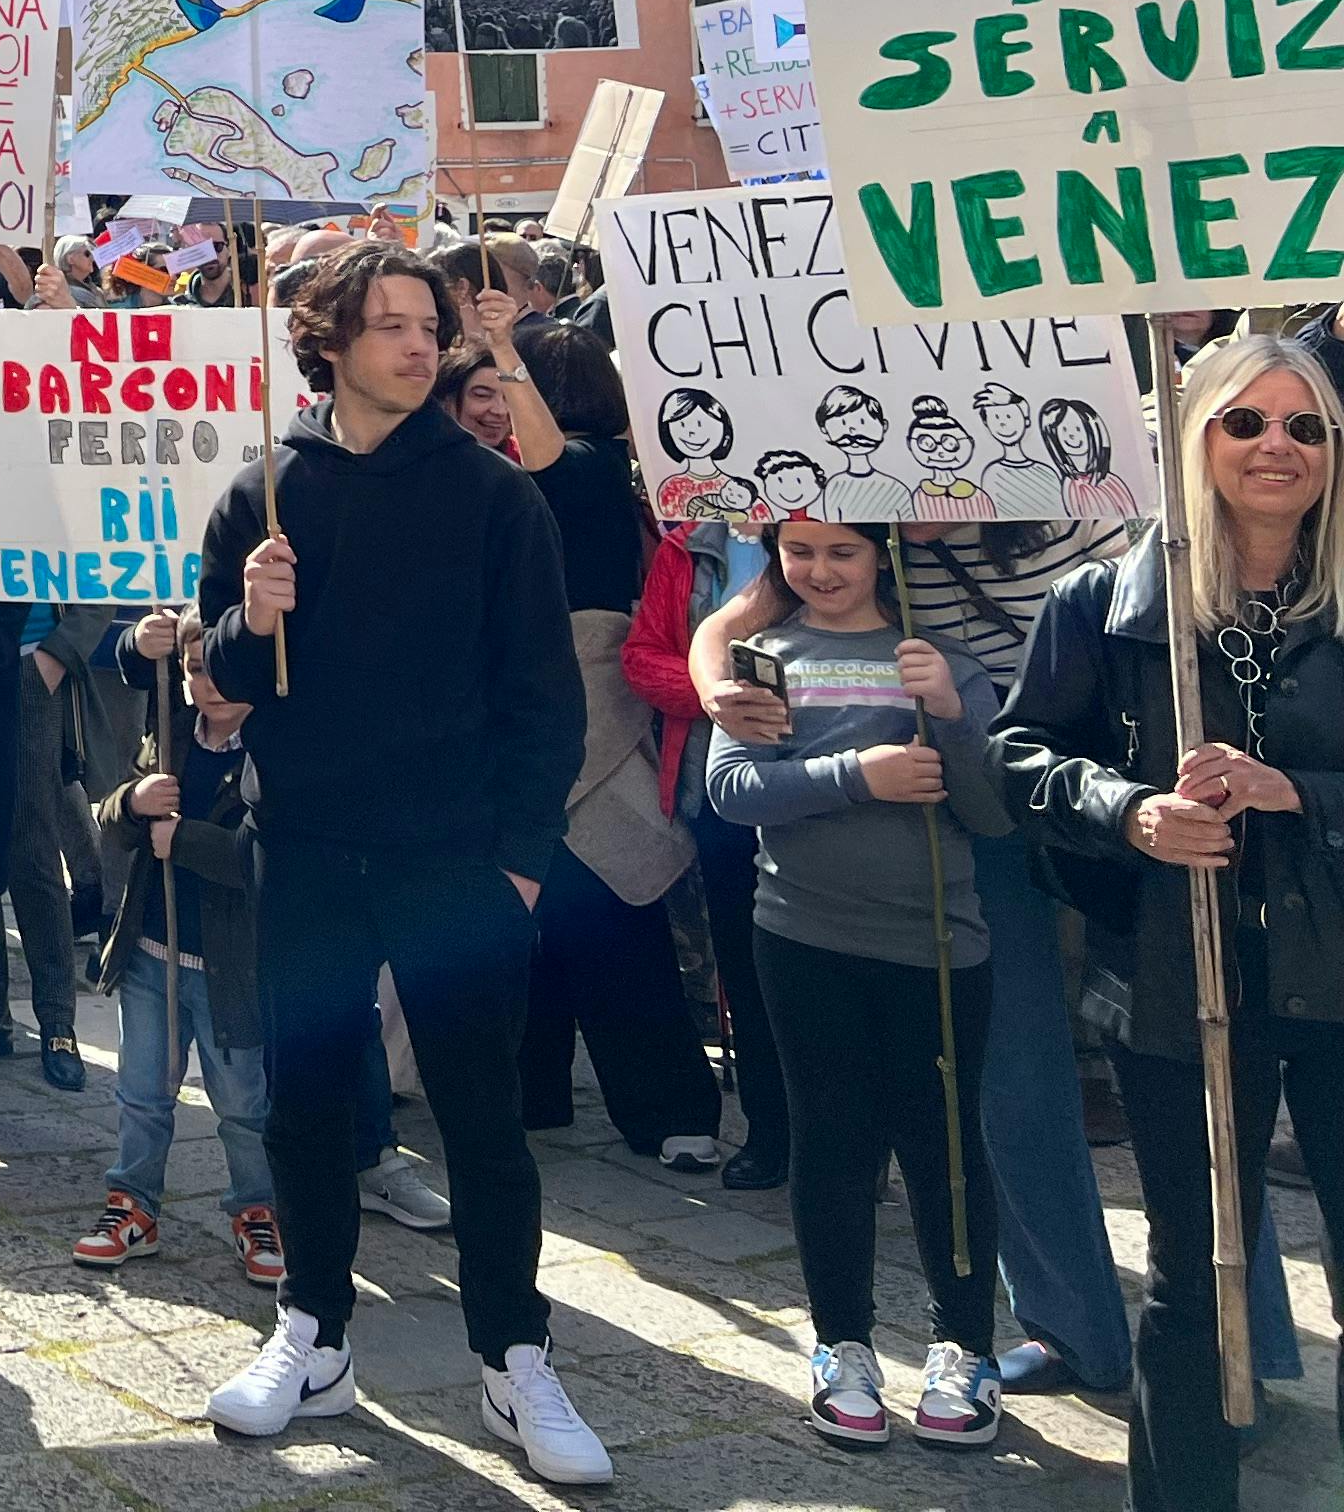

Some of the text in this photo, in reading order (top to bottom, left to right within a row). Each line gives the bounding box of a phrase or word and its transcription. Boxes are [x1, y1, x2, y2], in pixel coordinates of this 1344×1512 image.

[71, 311, 172, 363] NO
[647, 293, 784, 379] CHI
[48, 418, 219, 466] FERRO
